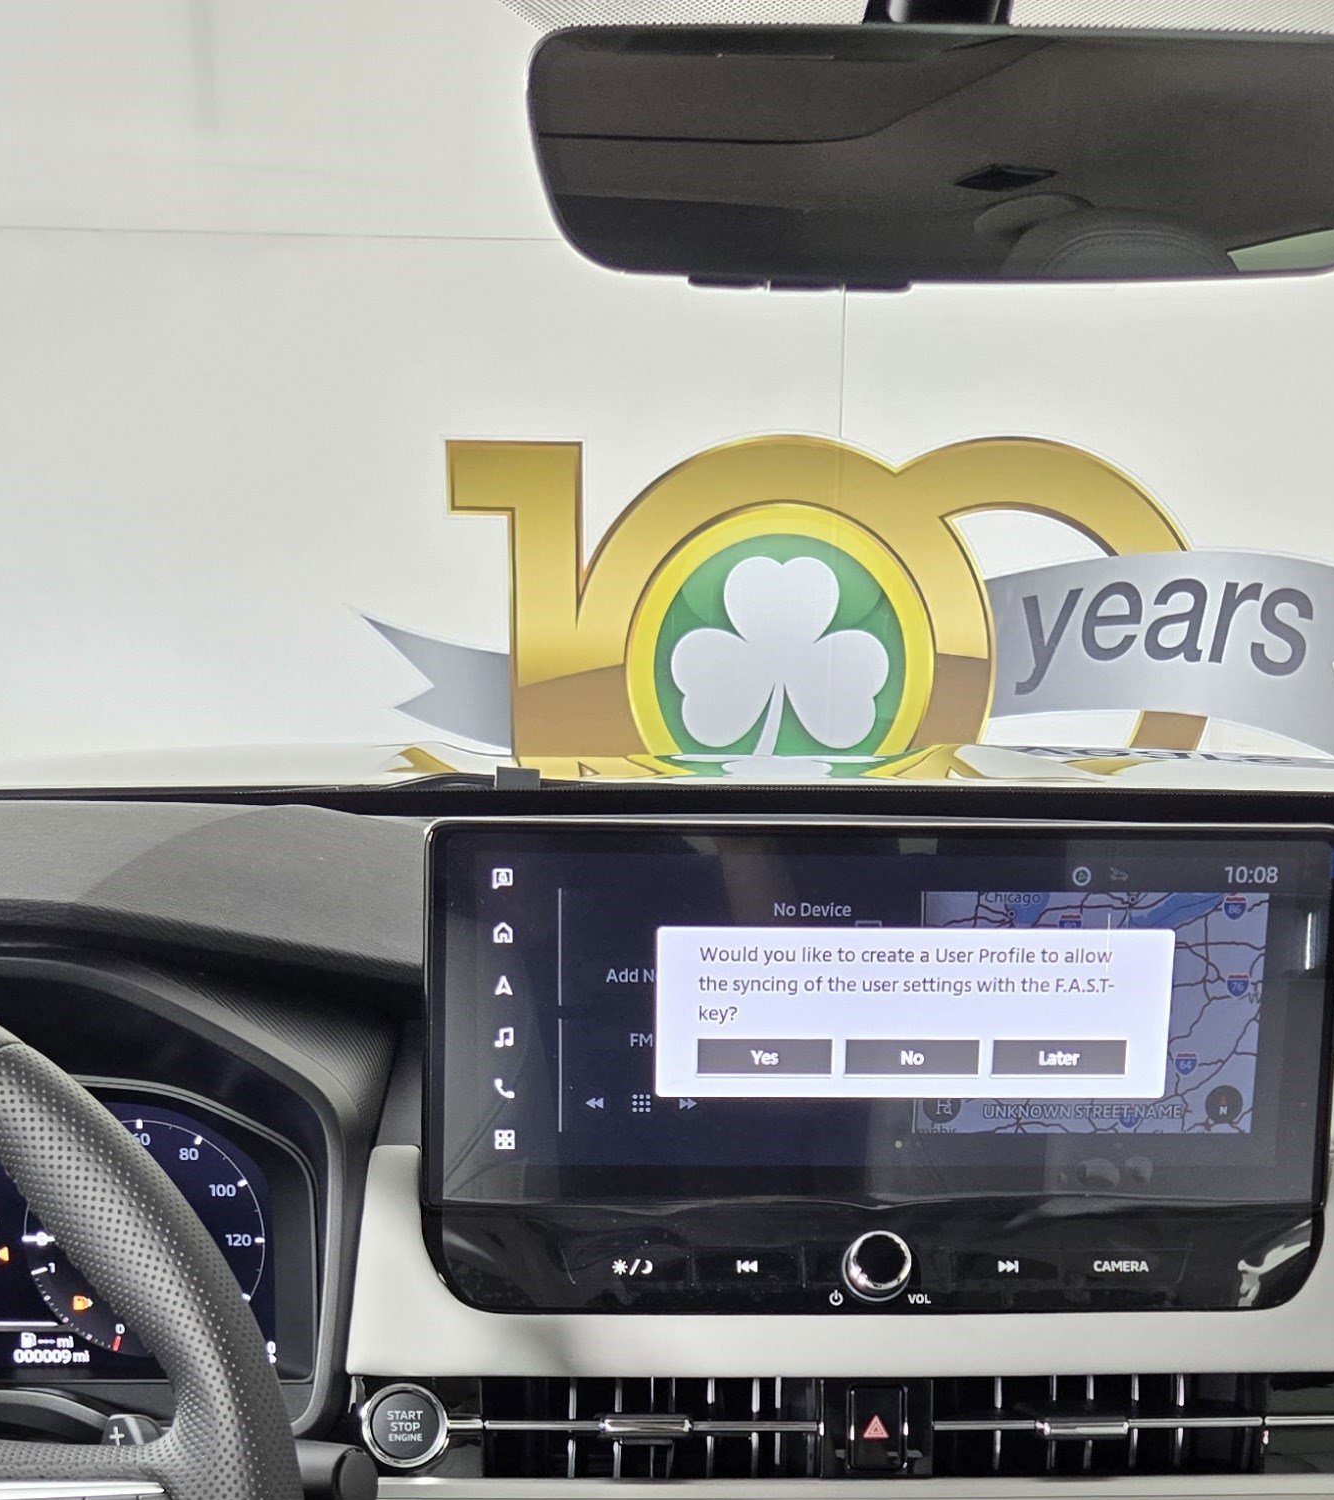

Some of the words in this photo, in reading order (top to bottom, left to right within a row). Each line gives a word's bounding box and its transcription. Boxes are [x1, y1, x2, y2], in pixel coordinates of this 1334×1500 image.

[1013, 573, 1314, 694] years
[1224, 866, 1279, 885] 10:08
[984, 892, 1042, 907] Chicago
[773, 903, 797, 918] No
[801, 902, 852, 918] Device
[699, 946, 758, 963] Would
[763, 950, 796, 967] you
[801, 946, 833, 963] like
[837, 948, 856, 963] to
[861, 948, 915, 964] create
[919, 952, 930, 964] a
[935, 947, 974, 964] User
[978, 947, 1036, 964] Profile
[1041, 949, 1060, 964] to
[1064, 947, 1113, 964] allow
[605, 968, 639, 984] Add
[698, 976, 728, 993] the
[732, 977, 799, 996] syncing
[803, 976, 824, 993] of
[827, 976, 857, 993] the
[862, 979, 898, 993] user
[902, 977, 972, 997] settings
[976, 977, 1017, 994] with
[1021, 977, 1050, 994] the
[1054, 978, 1115, 994] F.A.S.T-
[698, 1006, 739, 1025] key?
[629, 1033, 654, 1048] FM
[750, 1049, 780, 1067] Yes
[900, 1050, 925, 1066] No
[1038, 1050, 1081, 1068] Later
[983, 1103, 1071, 1120] UNKNOWN
[1074, 1103, 1132, 1120] STREET
[1133, 1103, 1184, 1119] NAME
[178, 1147, 200, 1161] 80
[208, 1183, 237, 1198] 100
[224, 1233, 253, 1248] 120
[48, 1261, 57, 1274] 1
[1093, 1259, 1149, 1274] CAMERA
[907, 1294, 931, 1304] VOL
[114, 1322, 127, 1336] 0
[13, 1349, 72, 1364] 000009
[72, 1349, 90, 1363] mi
[387, 1410, 423, 1420] START
[390, 1422, 420, 1432] STOP
[388, 1433, 423, 1442] ENGINE
